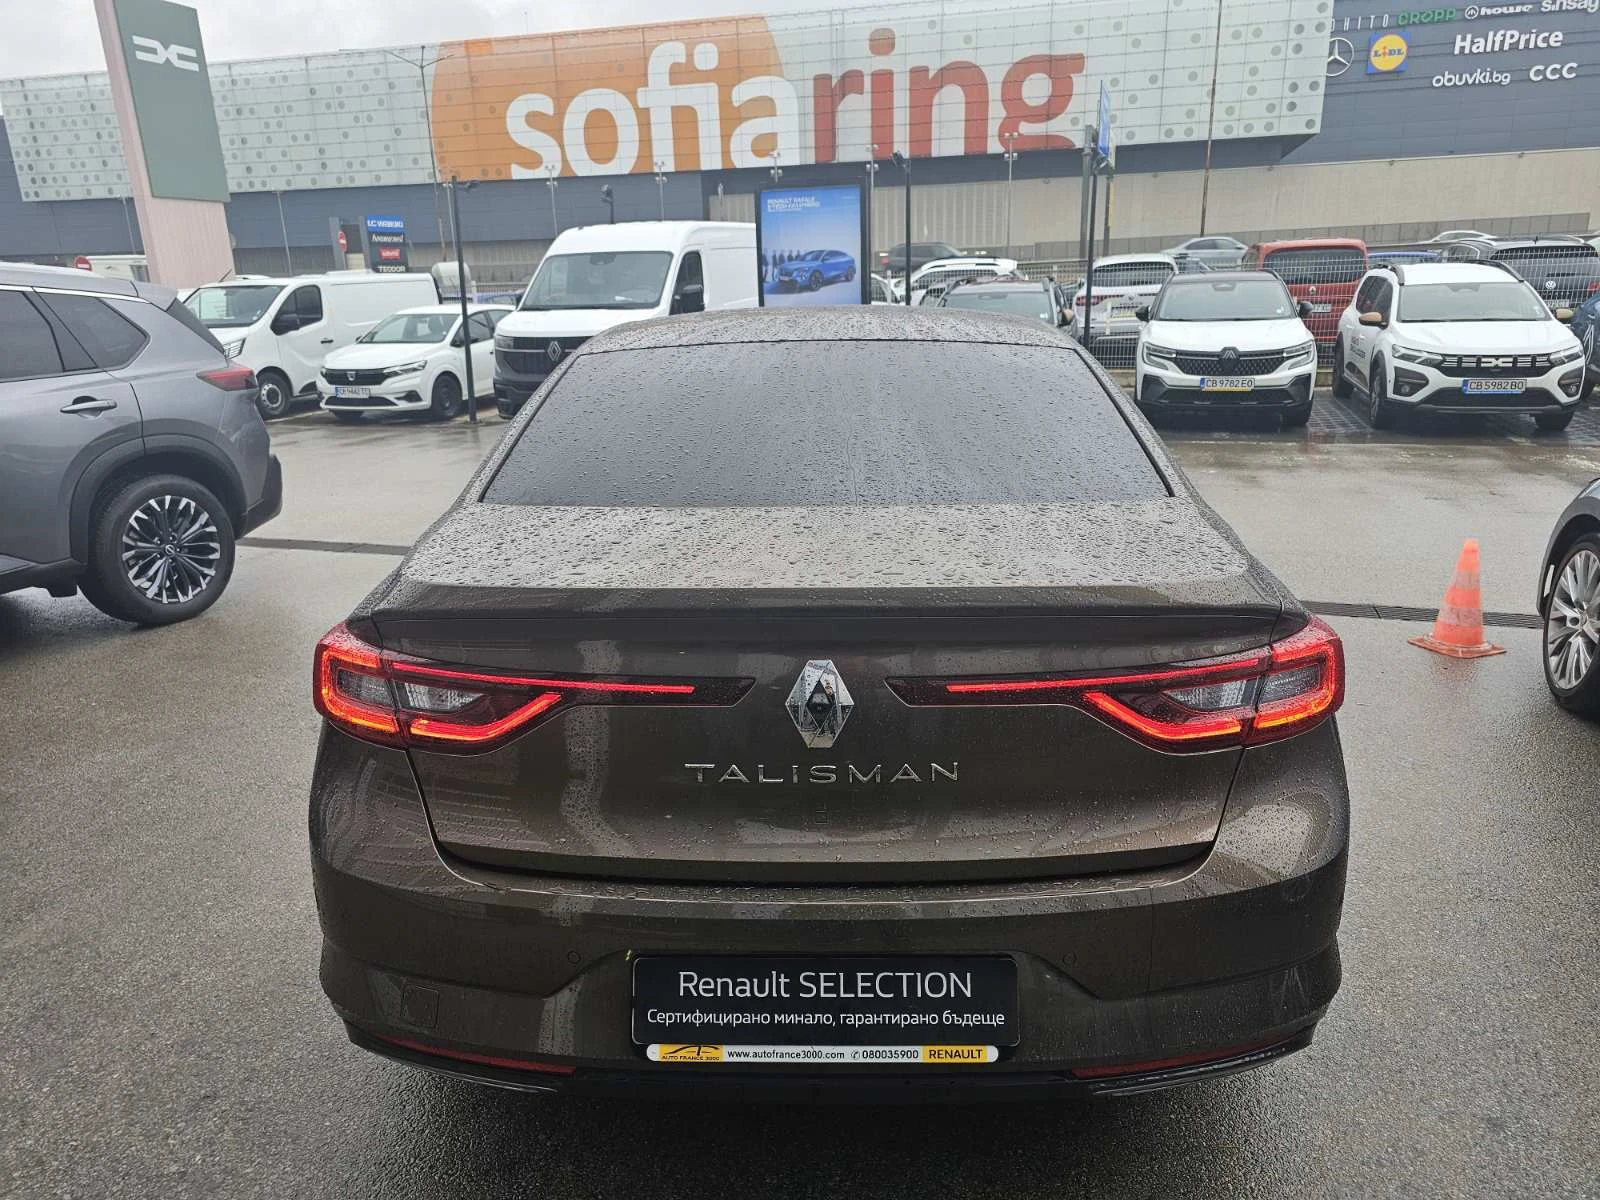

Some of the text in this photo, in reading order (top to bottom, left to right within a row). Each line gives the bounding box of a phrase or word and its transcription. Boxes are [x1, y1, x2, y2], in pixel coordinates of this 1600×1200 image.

[1397, 8, 1456, 26] CROPP
[1453, 29, 1563, 55] HalfPrice
[1432, 68, 1511, 88] obuvki.bg
[1529, 62, 1578, 82] CCC
[1469, 381, 1483, 390] CB
[1484, 381, 1509, 390] 5982
[684, 762, 959, 784] TALISMAN
[679, 970, 972, 998] Renault SELECTION
[647, 1009, 1005, 1028] Сертифицирано минало, гарантирано бъдеще
[727, 1048, 919, 1060] www.autofrance3000.com 080035900
[929, 1049, 983, 1060] RENAULT
